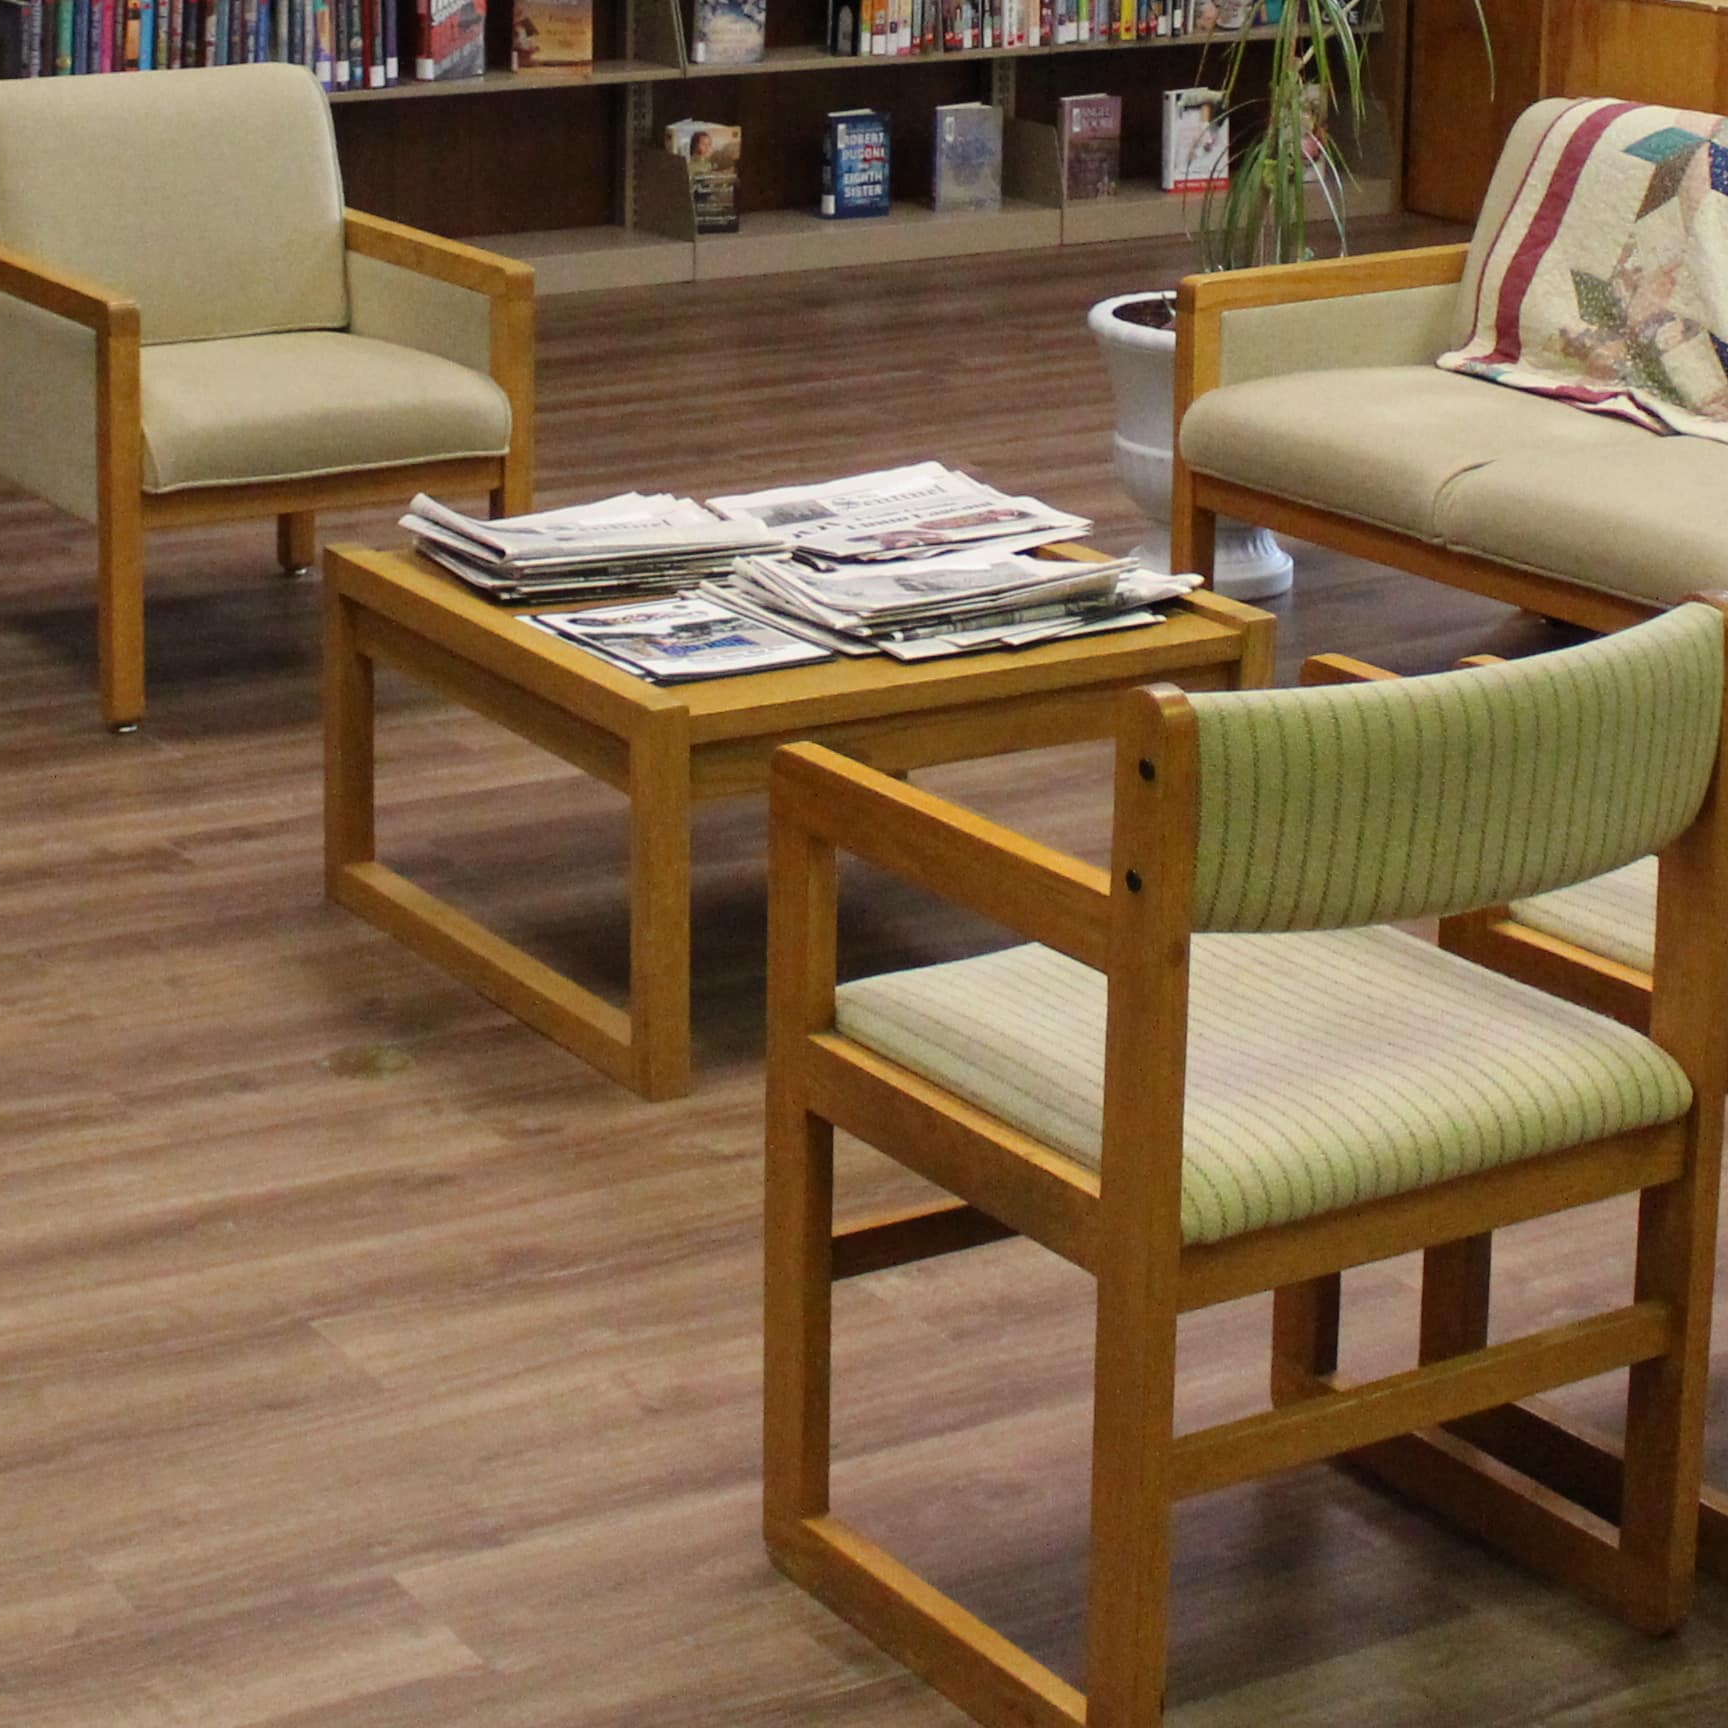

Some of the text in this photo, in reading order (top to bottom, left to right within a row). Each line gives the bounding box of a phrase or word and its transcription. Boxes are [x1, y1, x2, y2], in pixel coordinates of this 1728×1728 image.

[844, 131, 885, 145] ROBERT
[843, 170, 883, 184] EIGHTH
[843, 184, 883, 198] SISTER
[832, 484, 946, 513] Sentinel
